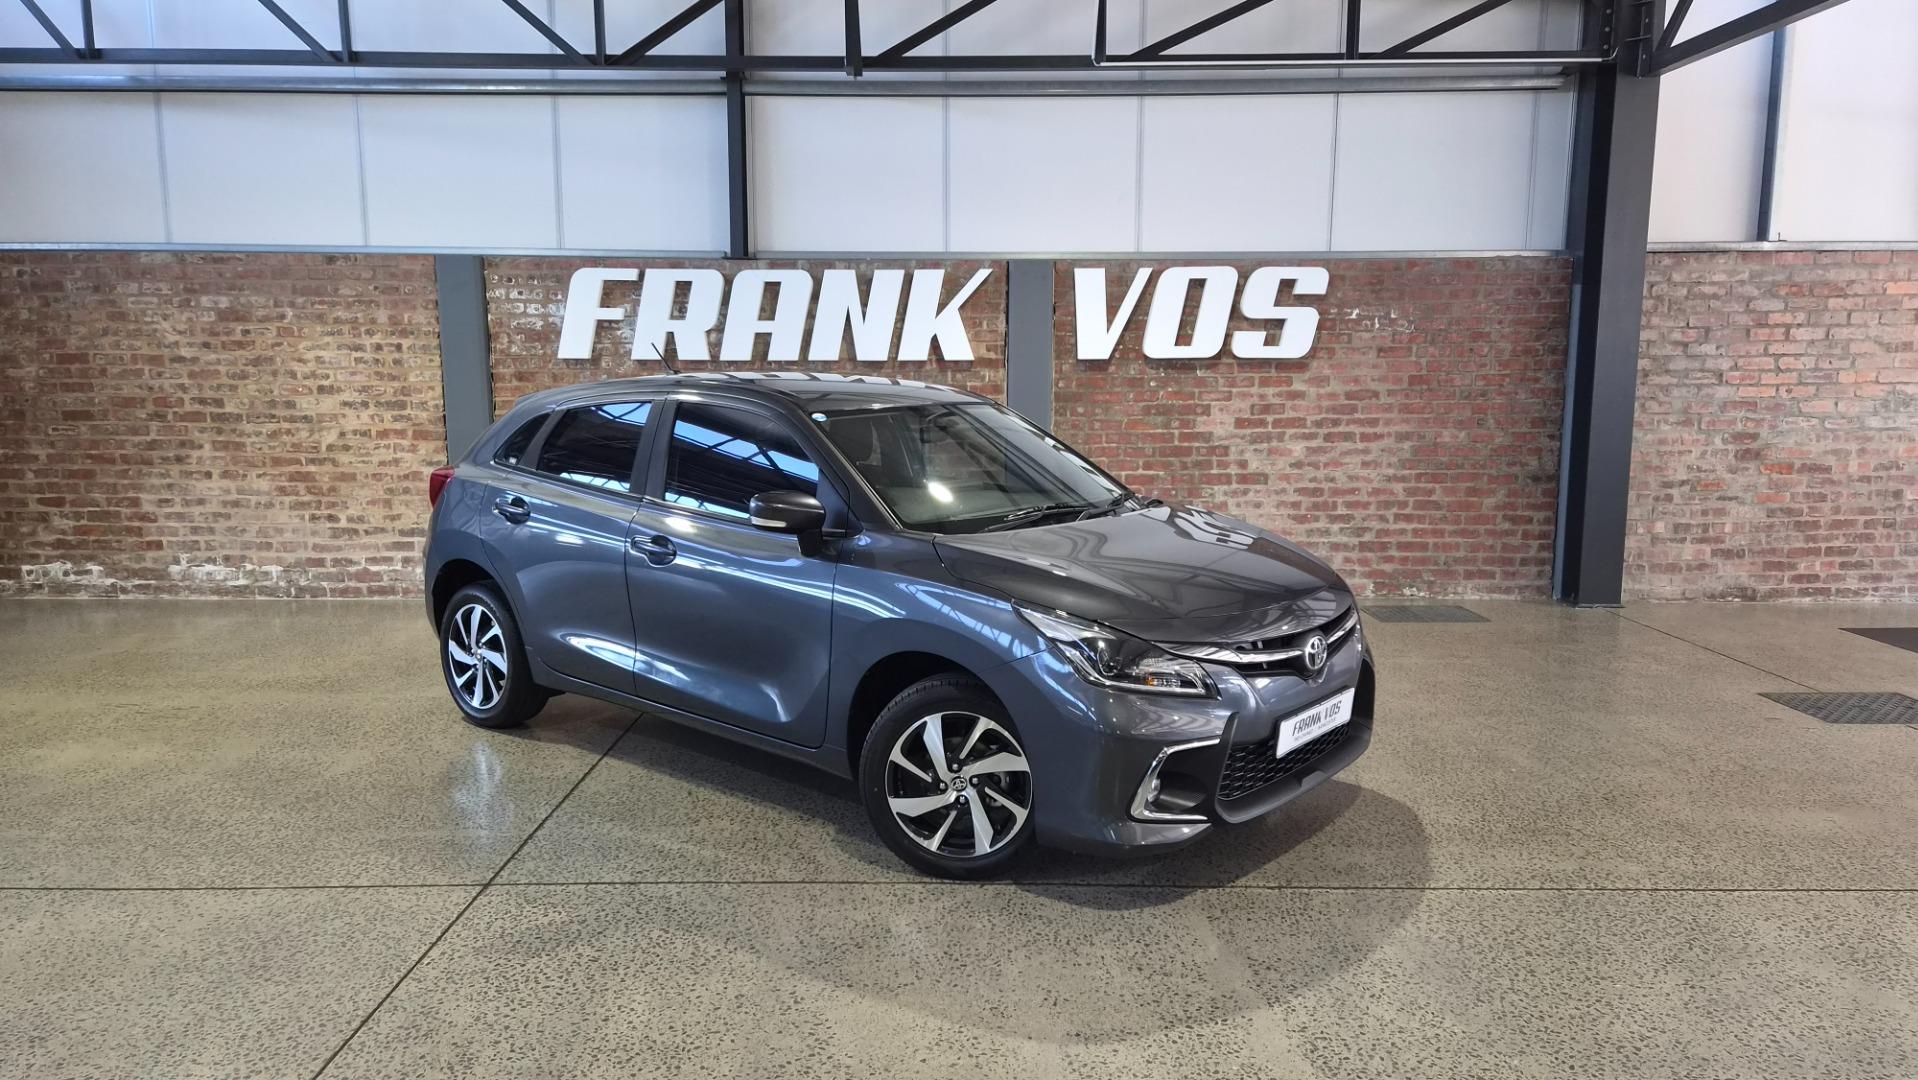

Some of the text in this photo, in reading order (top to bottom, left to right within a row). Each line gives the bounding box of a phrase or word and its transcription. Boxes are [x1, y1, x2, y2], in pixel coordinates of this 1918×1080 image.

[557, 266, 1330, 361] FRANK VOS
[1291, 711, 1322, 736] FRANK
